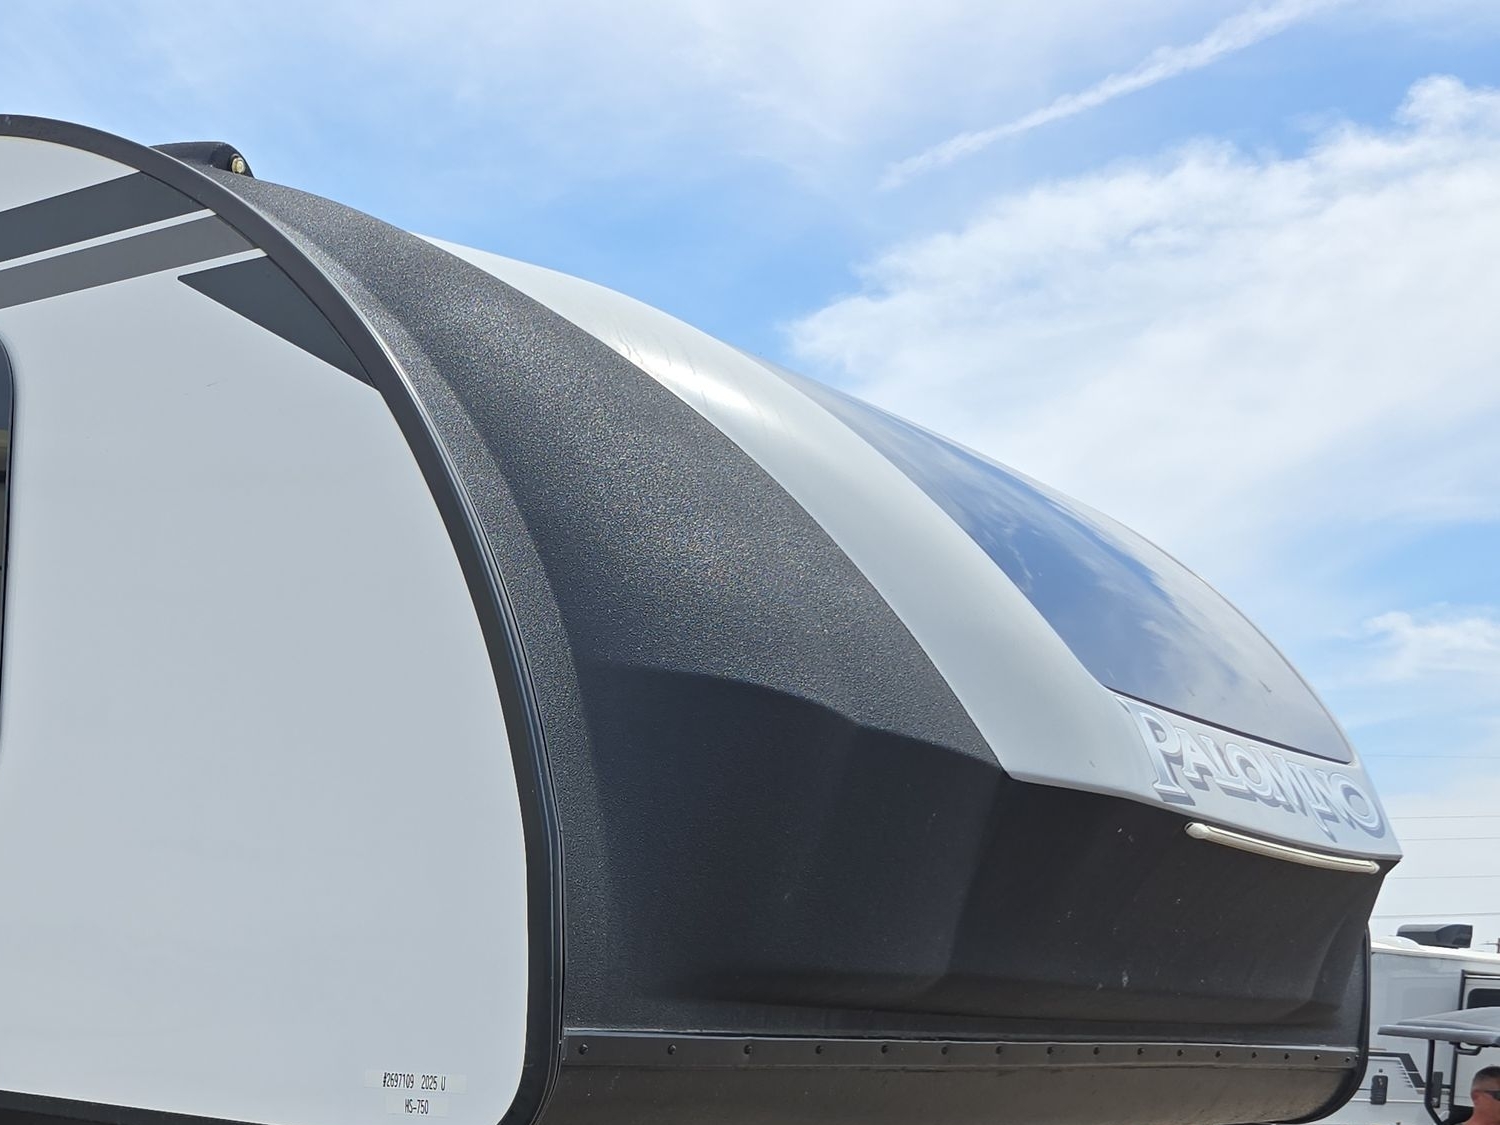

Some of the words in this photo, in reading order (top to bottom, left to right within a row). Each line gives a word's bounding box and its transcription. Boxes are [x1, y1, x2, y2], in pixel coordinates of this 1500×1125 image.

[1114, 695, 1386, 843] PALOMINO
[421, 1074, 438, 1091] 2025
[440, 1076, 446, 1092] U
[404, 1098, 429, 1115] HS-750
